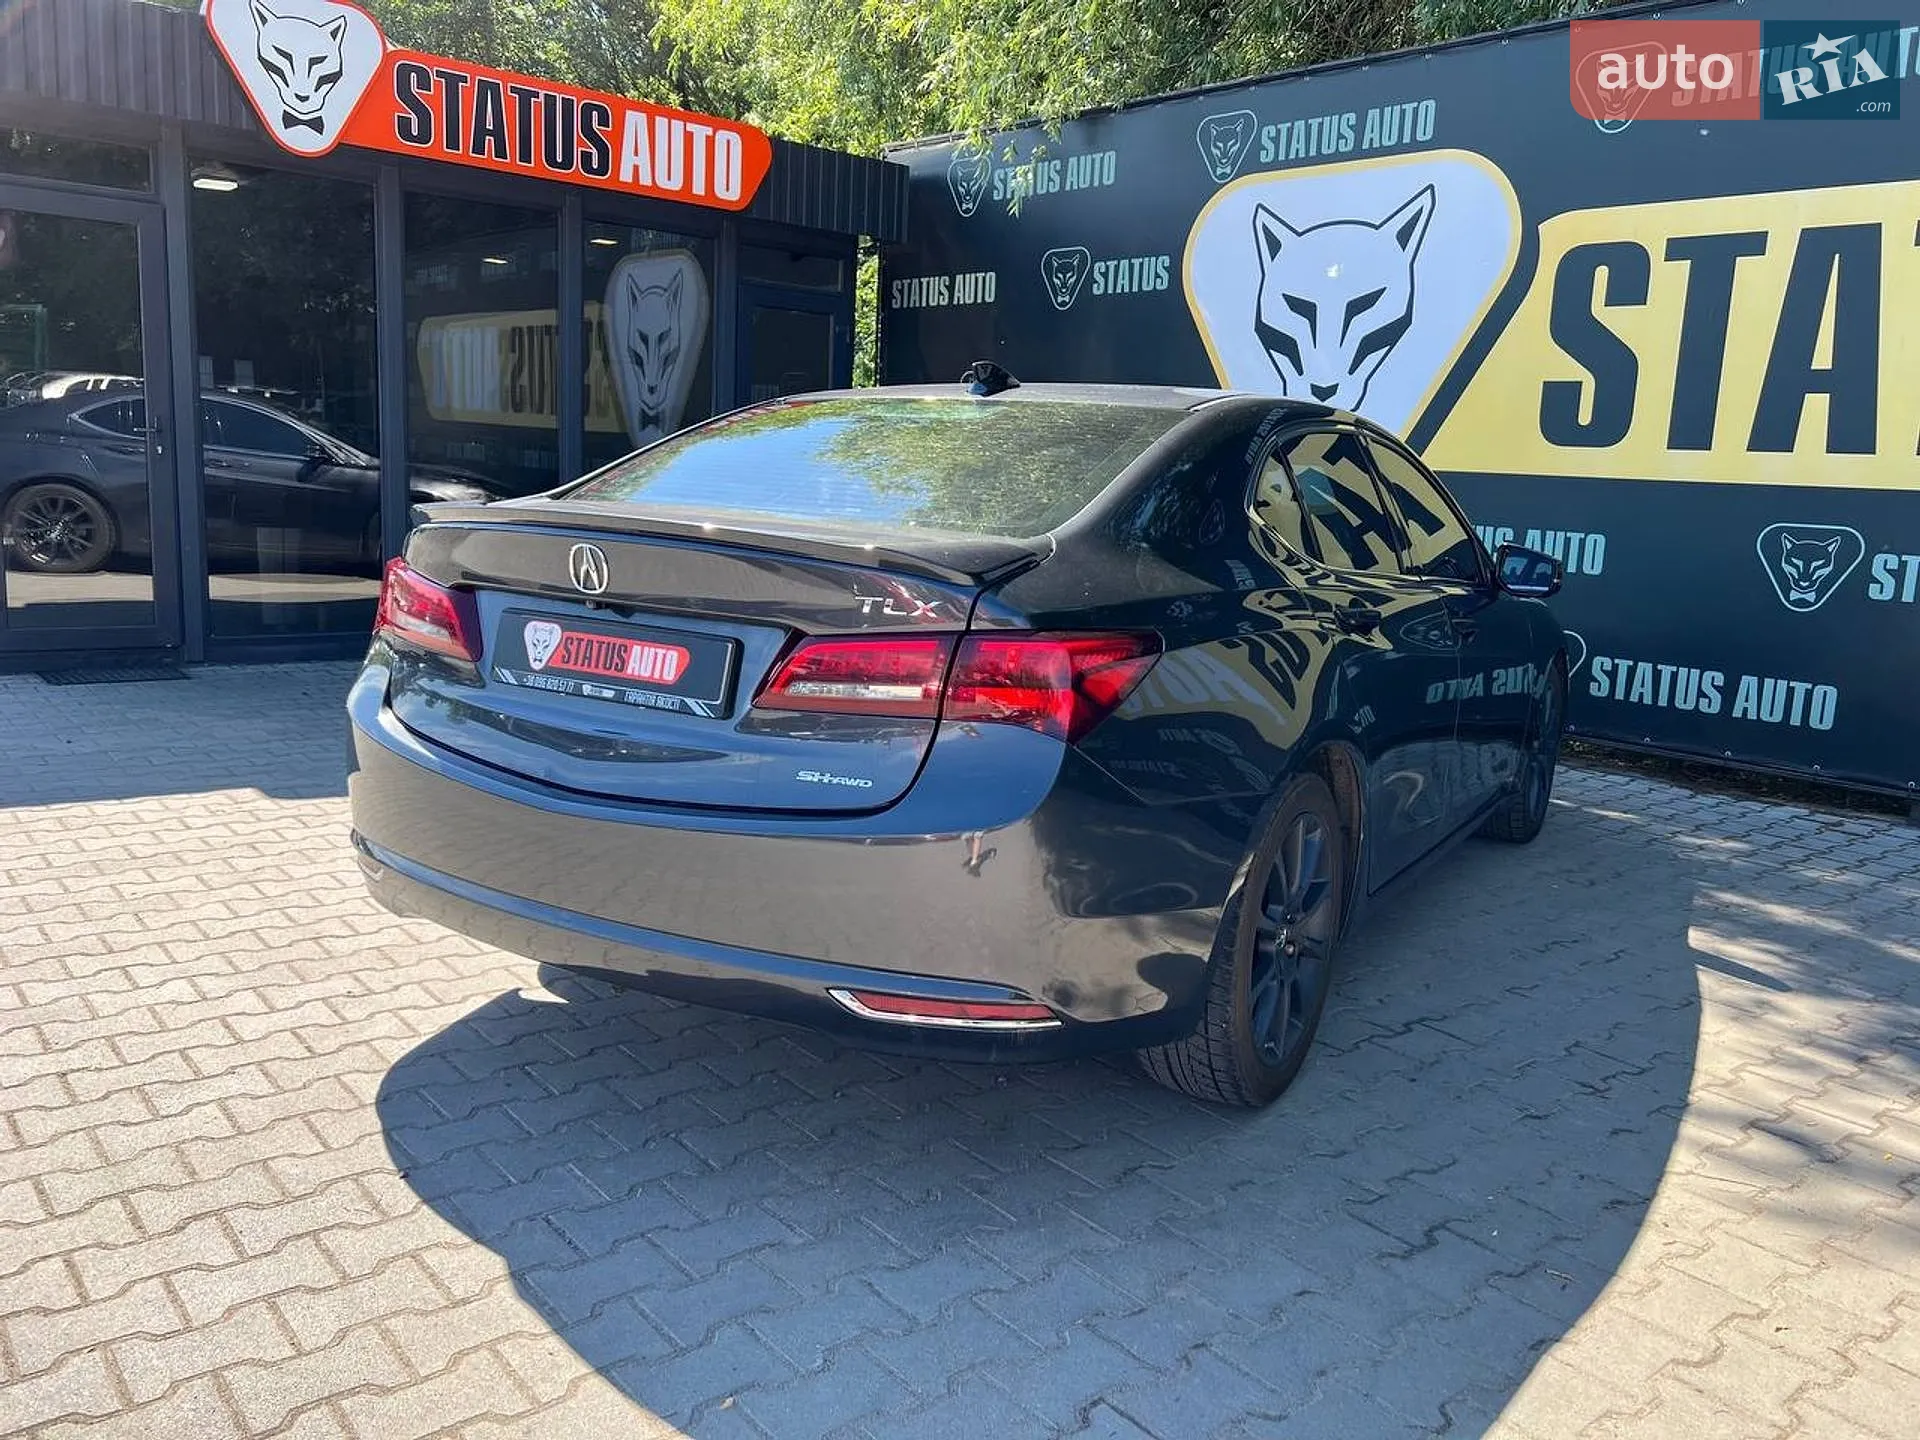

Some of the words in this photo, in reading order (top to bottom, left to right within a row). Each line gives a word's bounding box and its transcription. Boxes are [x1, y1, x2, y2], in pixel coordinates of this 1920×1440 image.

[393, 60, 612, 179] STATUS
[619, 109, 743, 202] AUTO
[1259, 112, 1356, 164] STATUS
[1362, 99, 1436, 149] AUTO
[1065, 150, 1116, 191] AUTO
[891, 275, 950, 309] STATUS
[953, 271, 997, 306] AUTO
[1092, 255, 1171, 296] STATUS
[1539, 220, 1920, 455] STA
[854, 595, 942, 619] TLX
[562, 636, 628, 672] STATUS
[627, 645, 679, 681] AUTO
[1589, 656, 1724, 714] STATUS
[1732, 675, 1839, 731] AUTO
